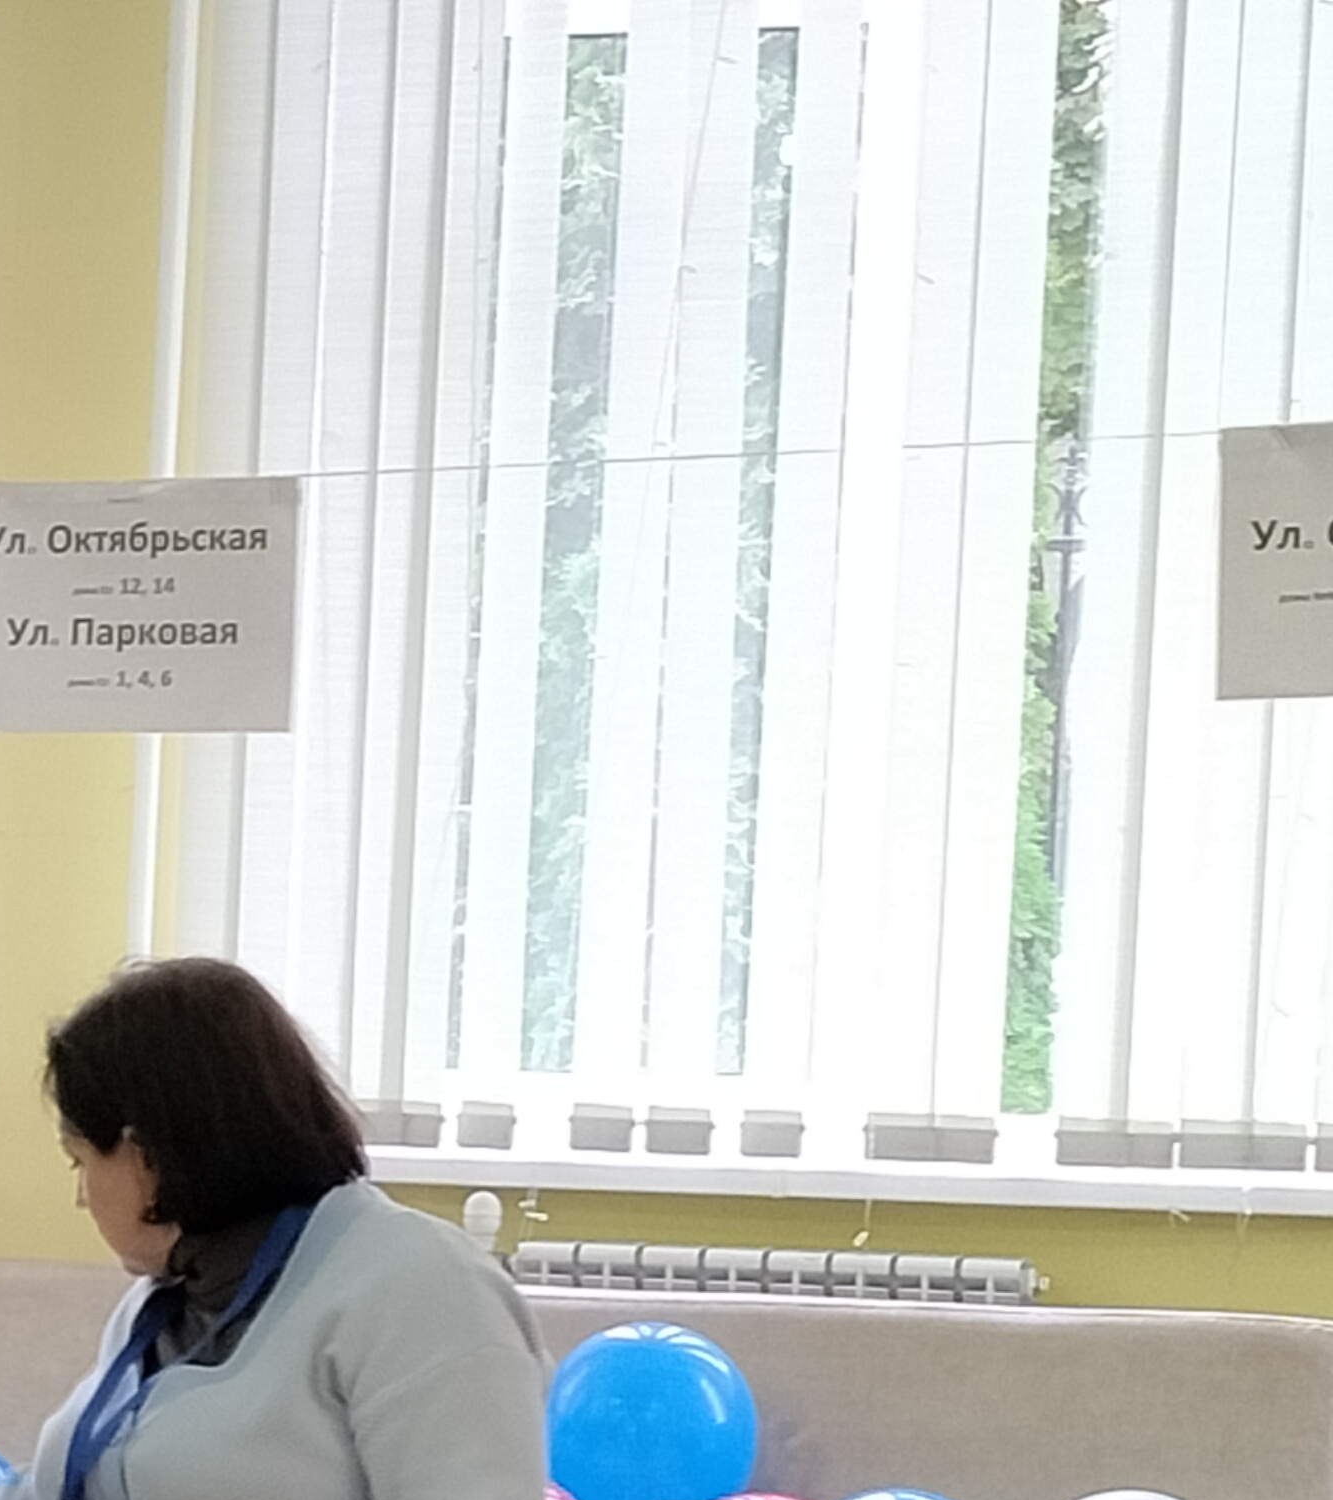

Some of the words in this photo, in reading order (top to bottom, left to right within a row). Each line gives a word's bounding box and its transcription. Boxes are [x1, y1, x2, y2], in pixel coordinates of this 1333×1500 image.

[47, 522, 267, 558] Октябрьская
[1252, 520, 1314, 550] Ул.
[153, 577, 175, 594] 14
[7, 618, 59, 646] Ул.
[71, 618, 238, 651] Парковая
[116, 671, 132, 689] 1,
[138, 671, 155, 689] 4,
